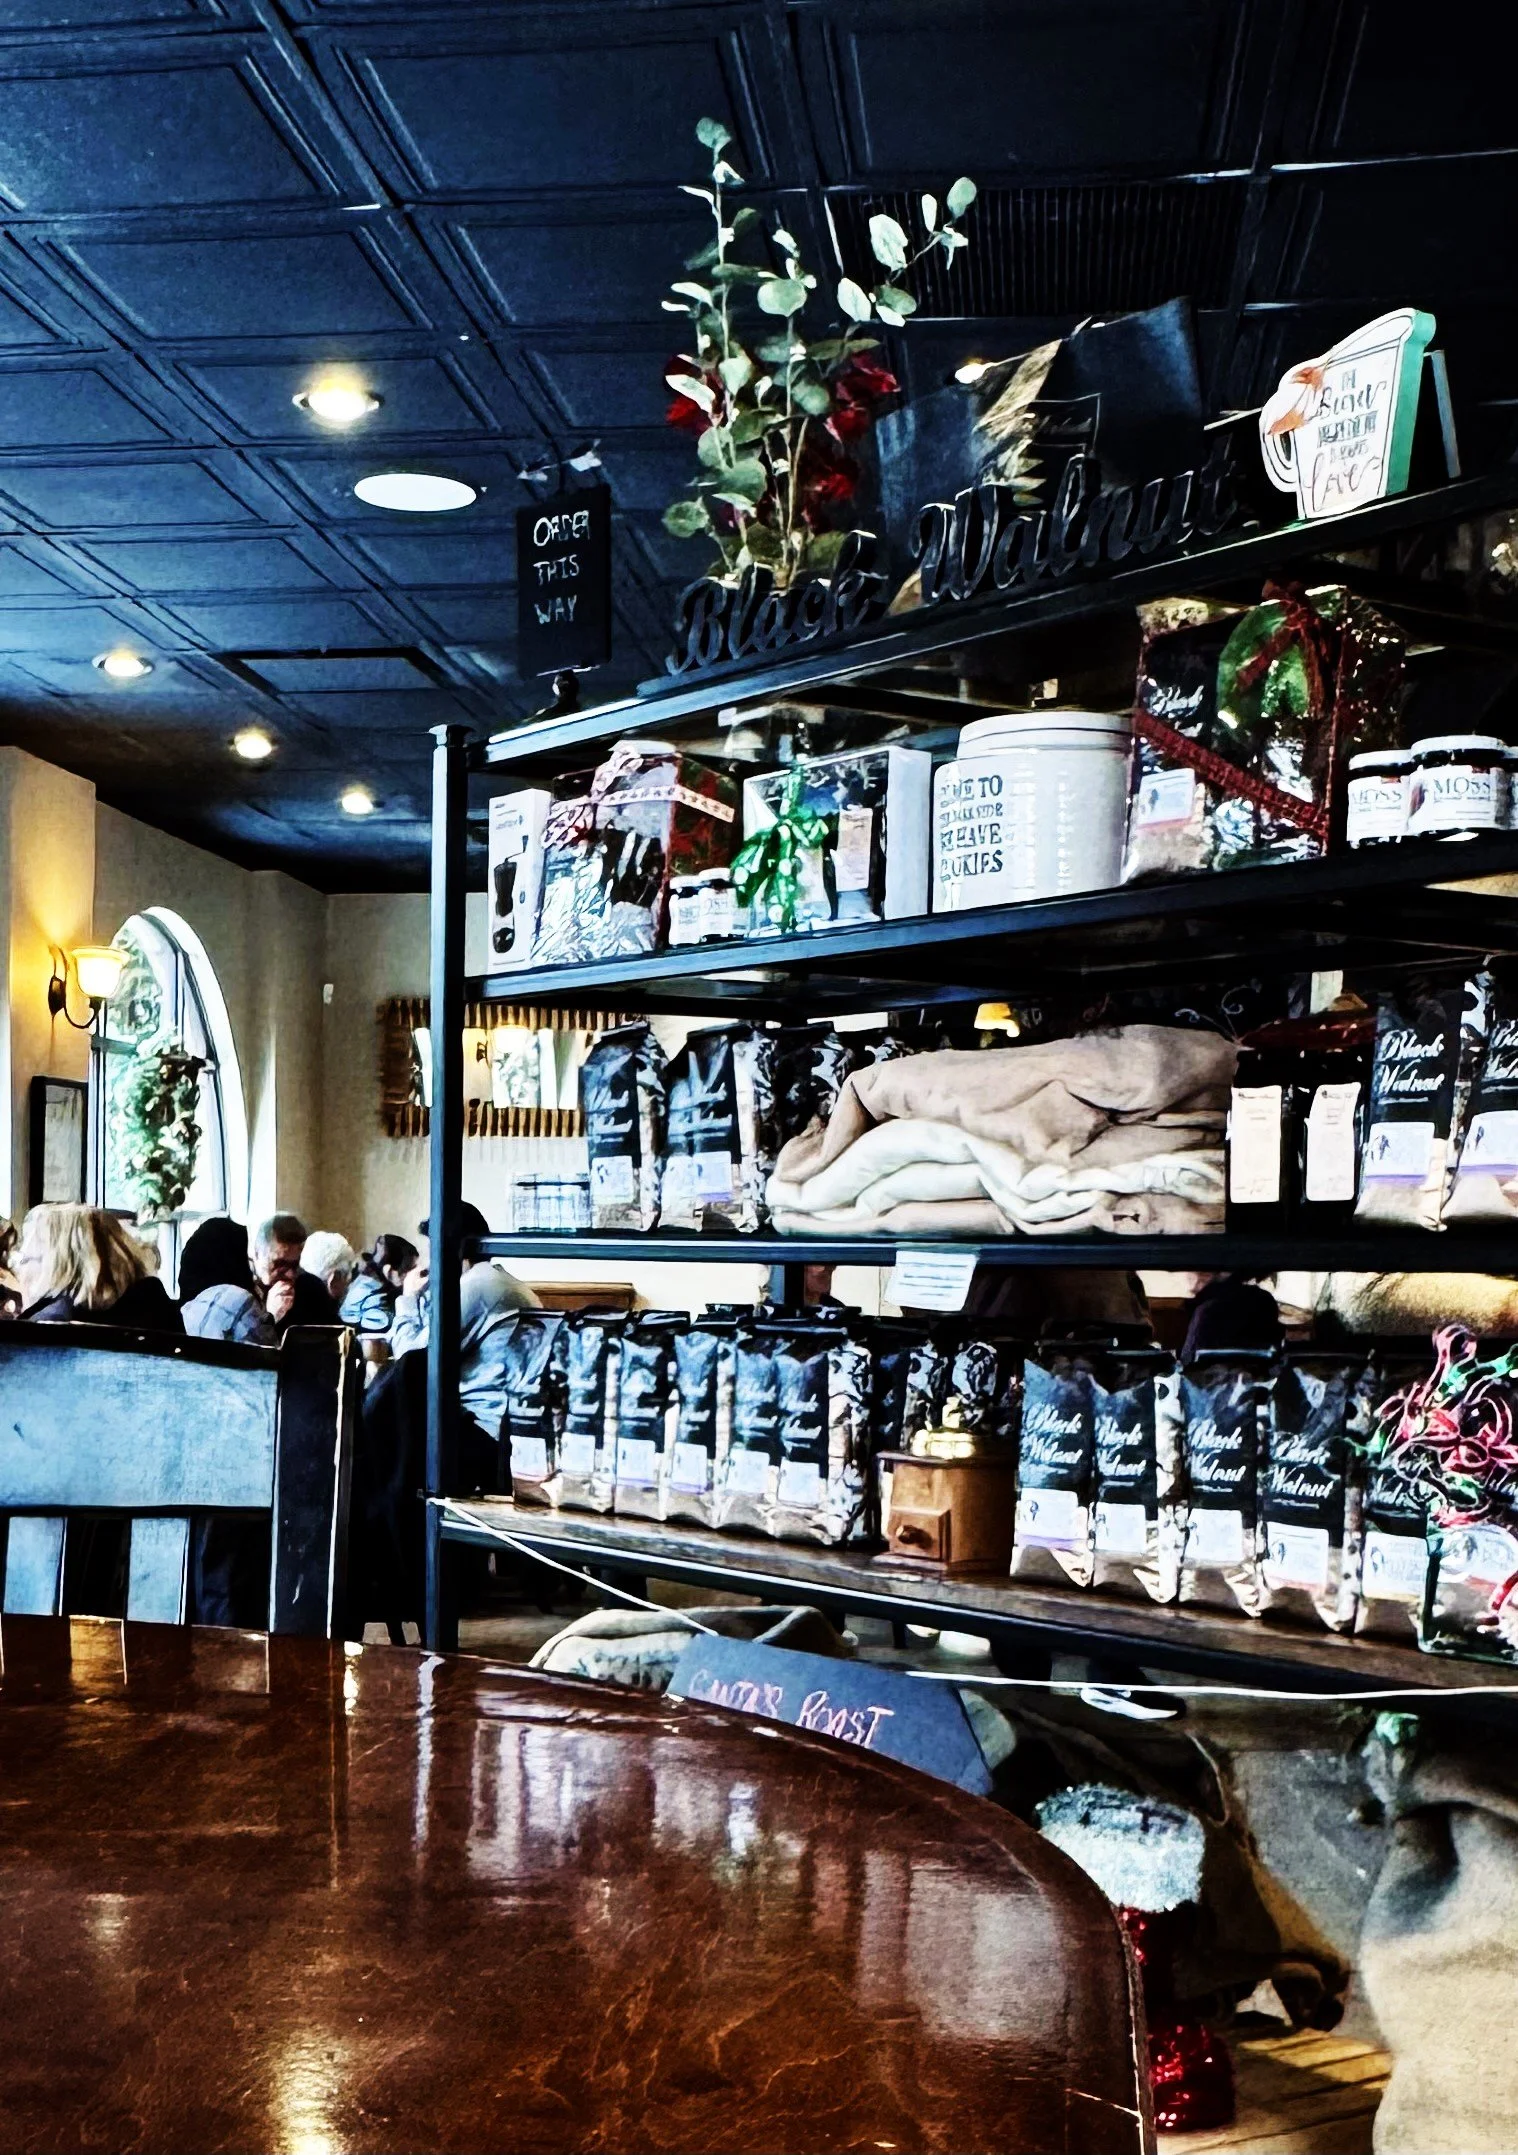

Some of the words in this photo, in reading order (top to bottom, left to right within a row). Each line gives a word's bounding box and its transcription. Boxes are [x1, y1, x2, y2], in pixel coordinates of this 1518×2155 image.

[533, 510, 590, 546] ORDER
[533, 554, 580, 585] THIS
[665, 529, 889, 676] Black
[912, 433, 1259, 601] Walnut
[534, 595, 578, 625] WAY
[978, 774, 1004, 798] TO
[795, 1689, 896, 1749] ROAST
